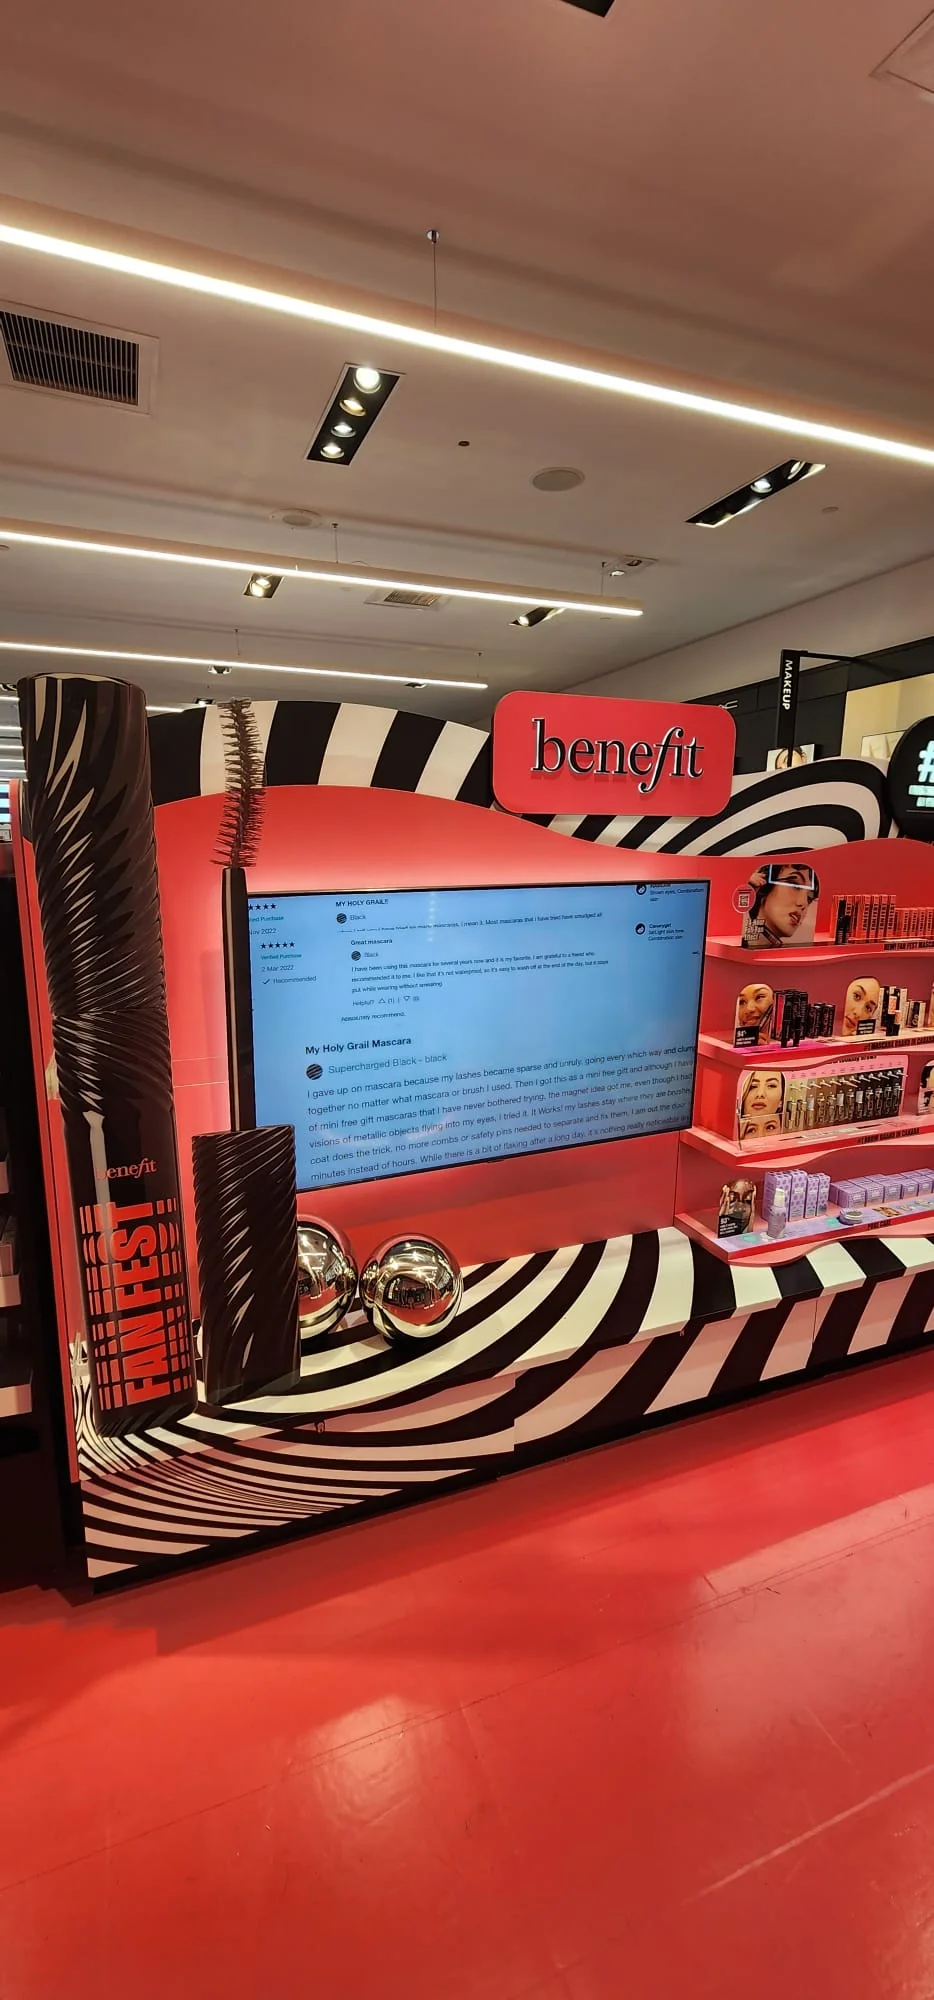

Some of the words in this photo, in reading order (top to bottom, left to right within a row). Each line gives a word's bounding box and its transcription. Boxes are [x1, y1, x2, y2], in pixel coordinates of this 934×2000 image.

[781, 659, 794, 711] MAKEUP
[530, 717, 705, 794] benefit
[305, 1045, 320, 1056] My
[323, 1043, 344, 1053] Holy
[347, 1040, 369, 1050] Grail
[372, 1038, 412, 1048] Mascara
[312, 1089, 335, 1100] gave
[337, 1087, 349, 1096] up
[365, 1081, 402, 1091] mascara
[404, 1076, 439, 1086] because
[441, 1075, 454, 1083] my
[456, 1071, 481, 1080] lashes
[483, 1067, 515, 1077] became
[516, 1064, 542, 1074] sparse
[543, 1060, 558, 1069] and
[585, 1056, 605, 1067] going
[606, 1054, 625, 1062] every
[626, 1050, 647, 1059] which
[648, 1050, 662, 1058] way
[663, 1046, 676, 1055] and
[328, 1059, 390, 1074] Supercharged
[393, 1056, 417, 1066] Black
[425, 1052, 448, 1063] black
[308, 1103, 345, 1116] together
[361, 1098, 389, 1108] matter
[391, 1094, 412, 1104] what
[414, 1091, 450, 1101] mascara
[462, 1085, 484, 1095] brush
[491, 1081, 512, 1091] used.
[514, 1080, 533, 1088] Then
[539, 1076, 552, 1087] got
[554, 1075, 568, 1083] this
[586, 1070, 601, 1079] mini
[616, 1067, 628, 1077] gift
[629, 1065, 642, 1073] and
[644, 1061, 673, 1072] although
[308, 1122, 317, 1131] of
[320, 1120, 339, 1130] mini
[341, 1119, 358, 1127] free
[360, 1115, 374, 1127] gift
[376, 1111, 417, 1122] mascaras
[419, 1107, 435, 1116] that
[442, 1105, 462, 1113] have
[464, 1102, 485, 1110] never
[487, 1095, 521, 1107] bothered
[548, 1091, 560, 1099] the
[561, 1087, 588, 1098] magnet
[590, 1085, 605, 1093] idea
[607, 1083, 618, 1093] got
[652, 1075, 675, 1085] though
[309, 1138, 341, 1148] visions
[342, 1134, 352, 1143] of
[354, 1130, 387, 1142] metallic
[389, 1126, 419, 1137] objects
[422, 1123, 443, 1133] flying
[445, 1120, 460, 1128] into
[462, 1119, 474, 1127] my
[504, 1110, 520, 1120] tried
[538, 1104, 563, 1115] Works!
[564, 1104, 576, 1112] my
[578, 1100, 600, 1109] lashes
[601, 1098, 615, 1106] stay
[310, 1155, 329, 1165] coat
[332, 1152, 354, 1161] does
[356, 1149, 370, 1158] the
[409, 1141, 429, 1149] more
[431, 1135, 459, 1146] combs
[496, 1128, 512, 1138] pins
[514, 1122, 542, 1133] needed
[553, 1116, 583, 1128] separate
[586, 1113, 598, 1122] and
[647, 1104, 658, 1112] out
[311, 1169, 346, 1181] minutes
[348, 1162, 379, 1175] instead
[381, 1161, 390, 1169] of
[392, 1158, 417, 1168] hours.
[420, 1153, 442, 1163] While
[444, 1150, 464, 1159] there
[482, 1145, 492, 1153] bit
[494, 1143, 501, 1151] of
[503, 1140, 528, 1150] flaking
[530, 1137, 546, 1146] after
[554, 1134, 570, 1142] long
[600, 1125, 625, 1134] nothing
[626, 1121, 644, 1130] really
